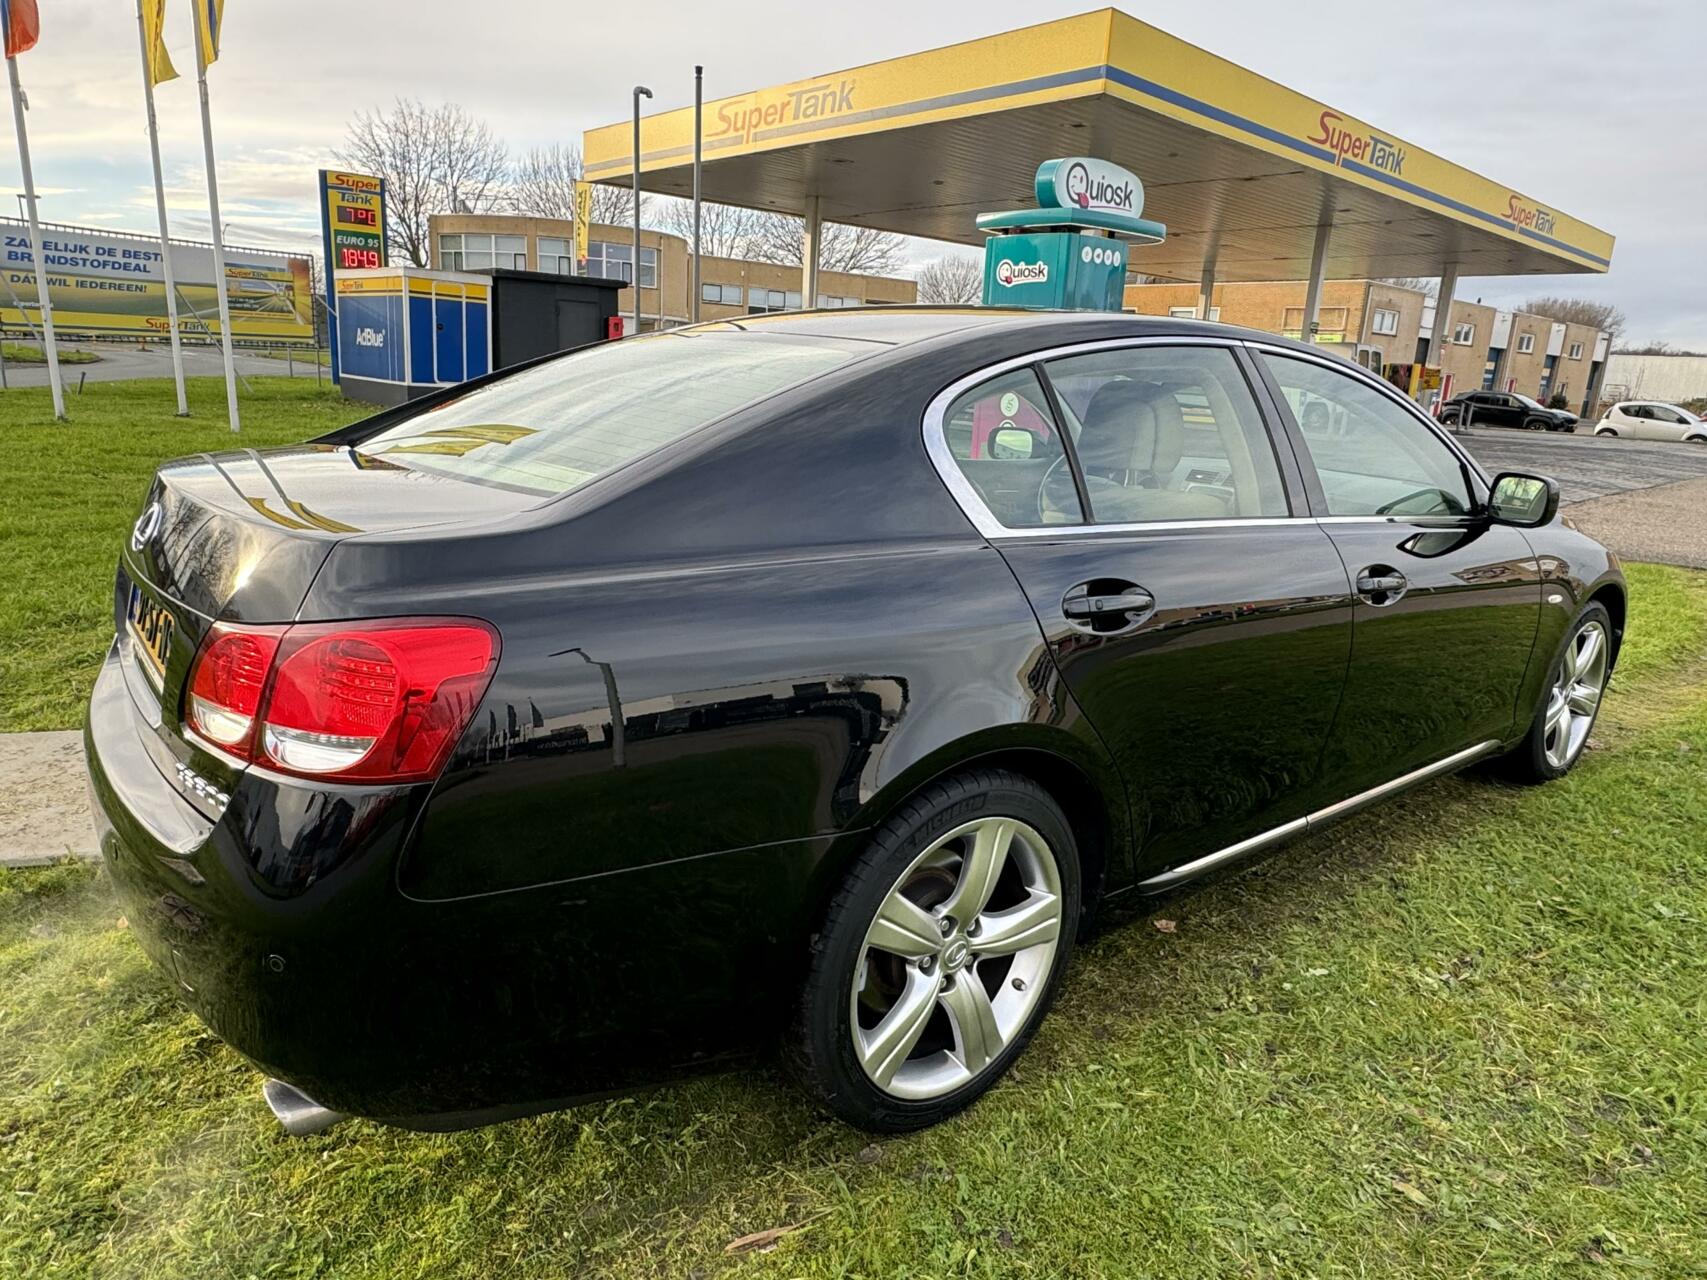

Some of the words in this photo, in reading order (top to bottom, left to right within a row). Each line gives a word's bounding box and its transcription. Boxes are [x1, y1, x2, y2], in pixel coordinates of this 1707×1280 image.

[335, 174, 380, 194] Super
[1066, 162, 1133, 209] Quiosk
[336, 190, 373, 206] Tank
[336, 235, 365, 246] EURO
[367, 238, 380, 248] 95
[95, 246, 118, 258] DE
[7, 250, 151, 273] BRNDSTOFDEAL
[998, 261, 1045, 283] Quiosk
[75, 279, 147, 293] IEDEREEN!
[145, 318, 210, 333] SuprTank
